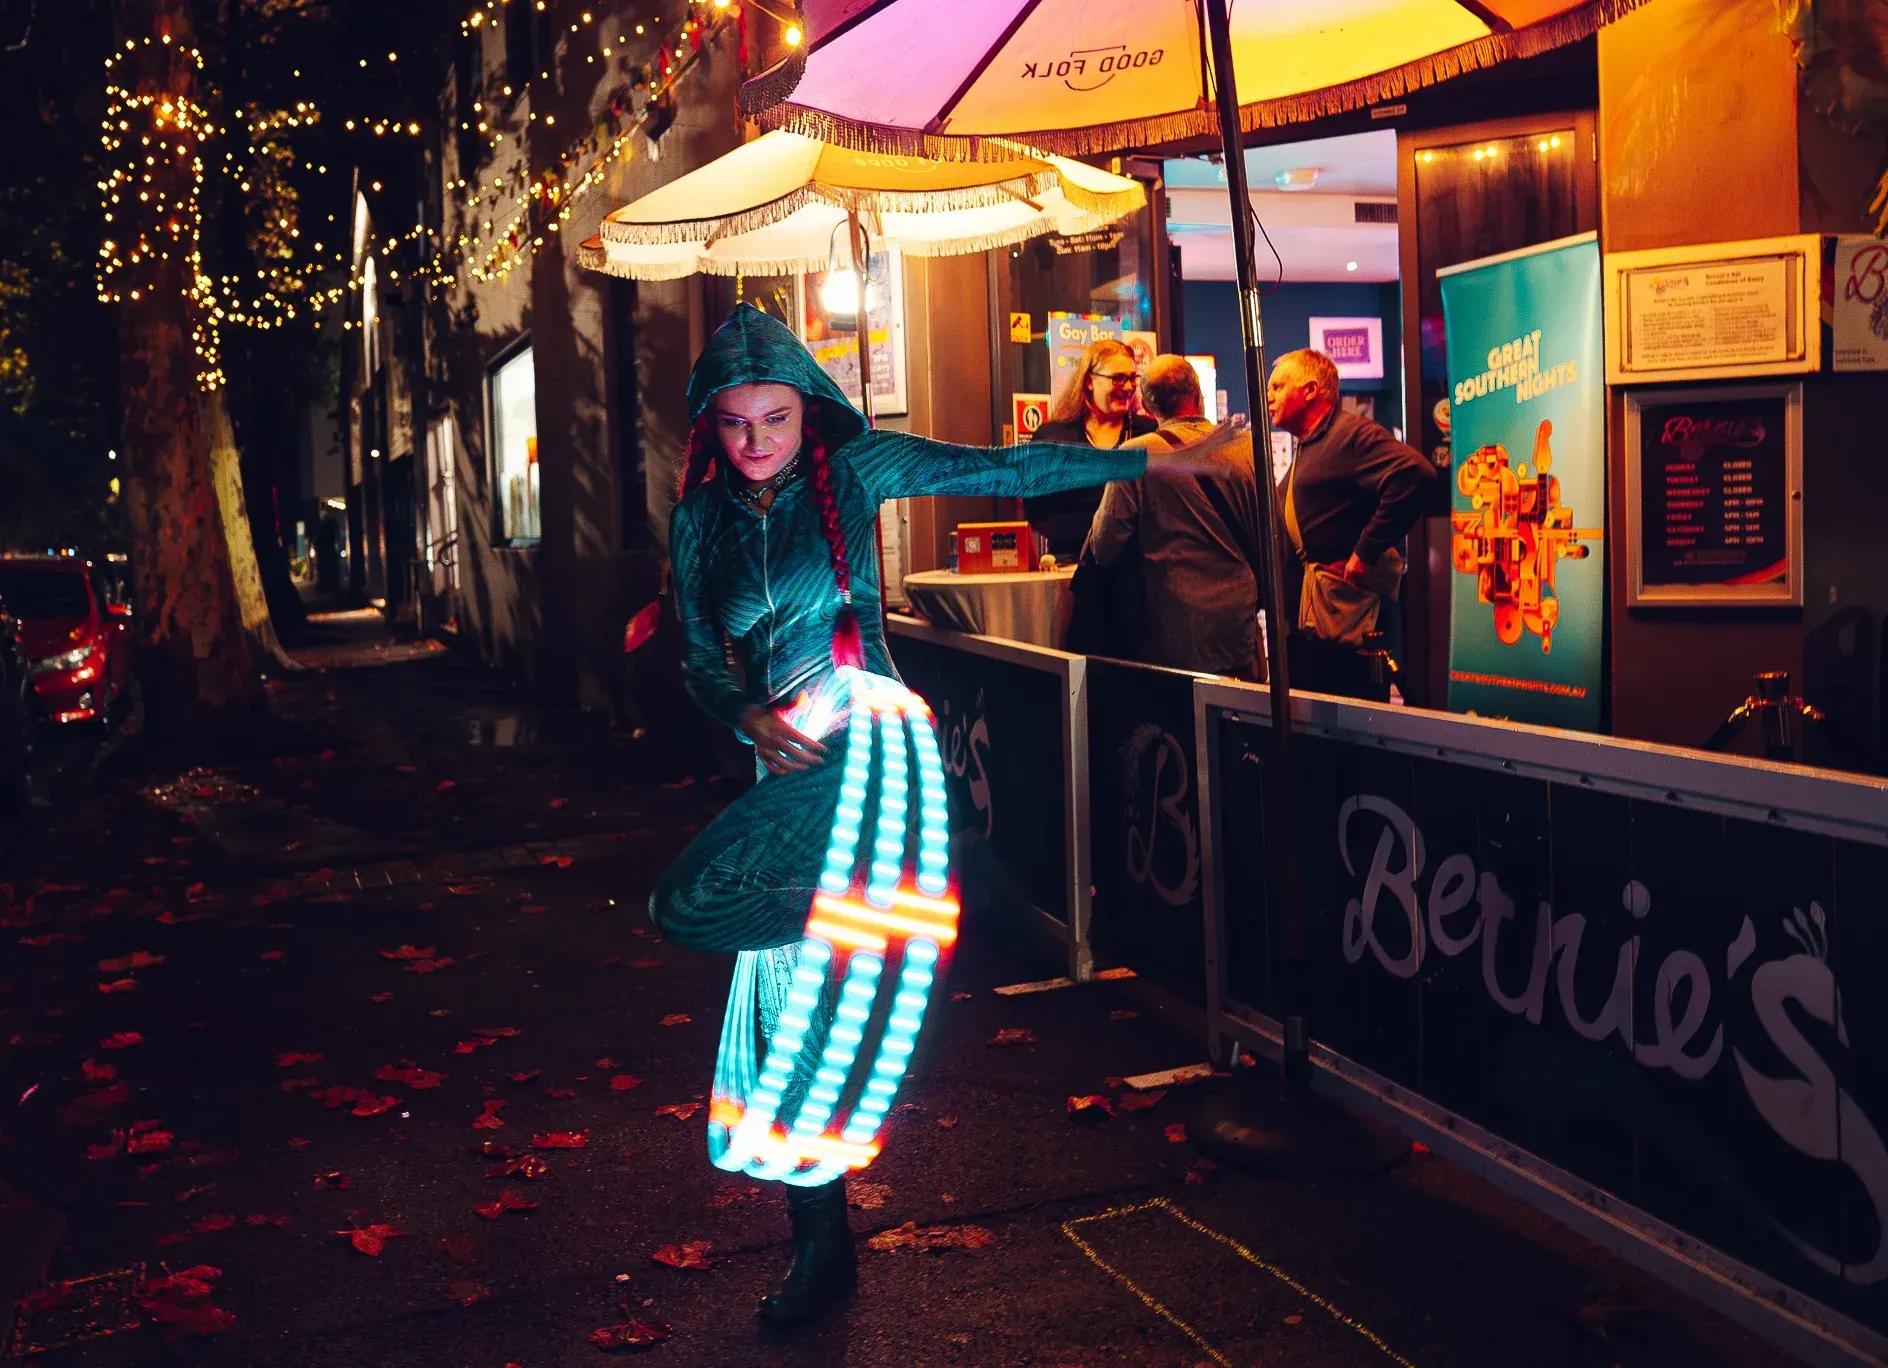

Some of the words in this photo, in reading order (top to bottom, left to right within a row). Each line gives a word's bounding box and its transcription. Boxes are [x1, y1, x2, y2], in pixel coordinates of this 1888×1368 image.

[1058, 321, 1087, 346] Gay
[1089, 324, 1115, 342] Bar
[1332, 346, 1362, 358] HERE
[1487, 329, 1541, 371] GREAT
[1455, 356, 1540, 405] SOUTHERN
[1516, 358, 1578, 404] NIGHTS
[1338, 794, 1888, 1285] Bernie's
